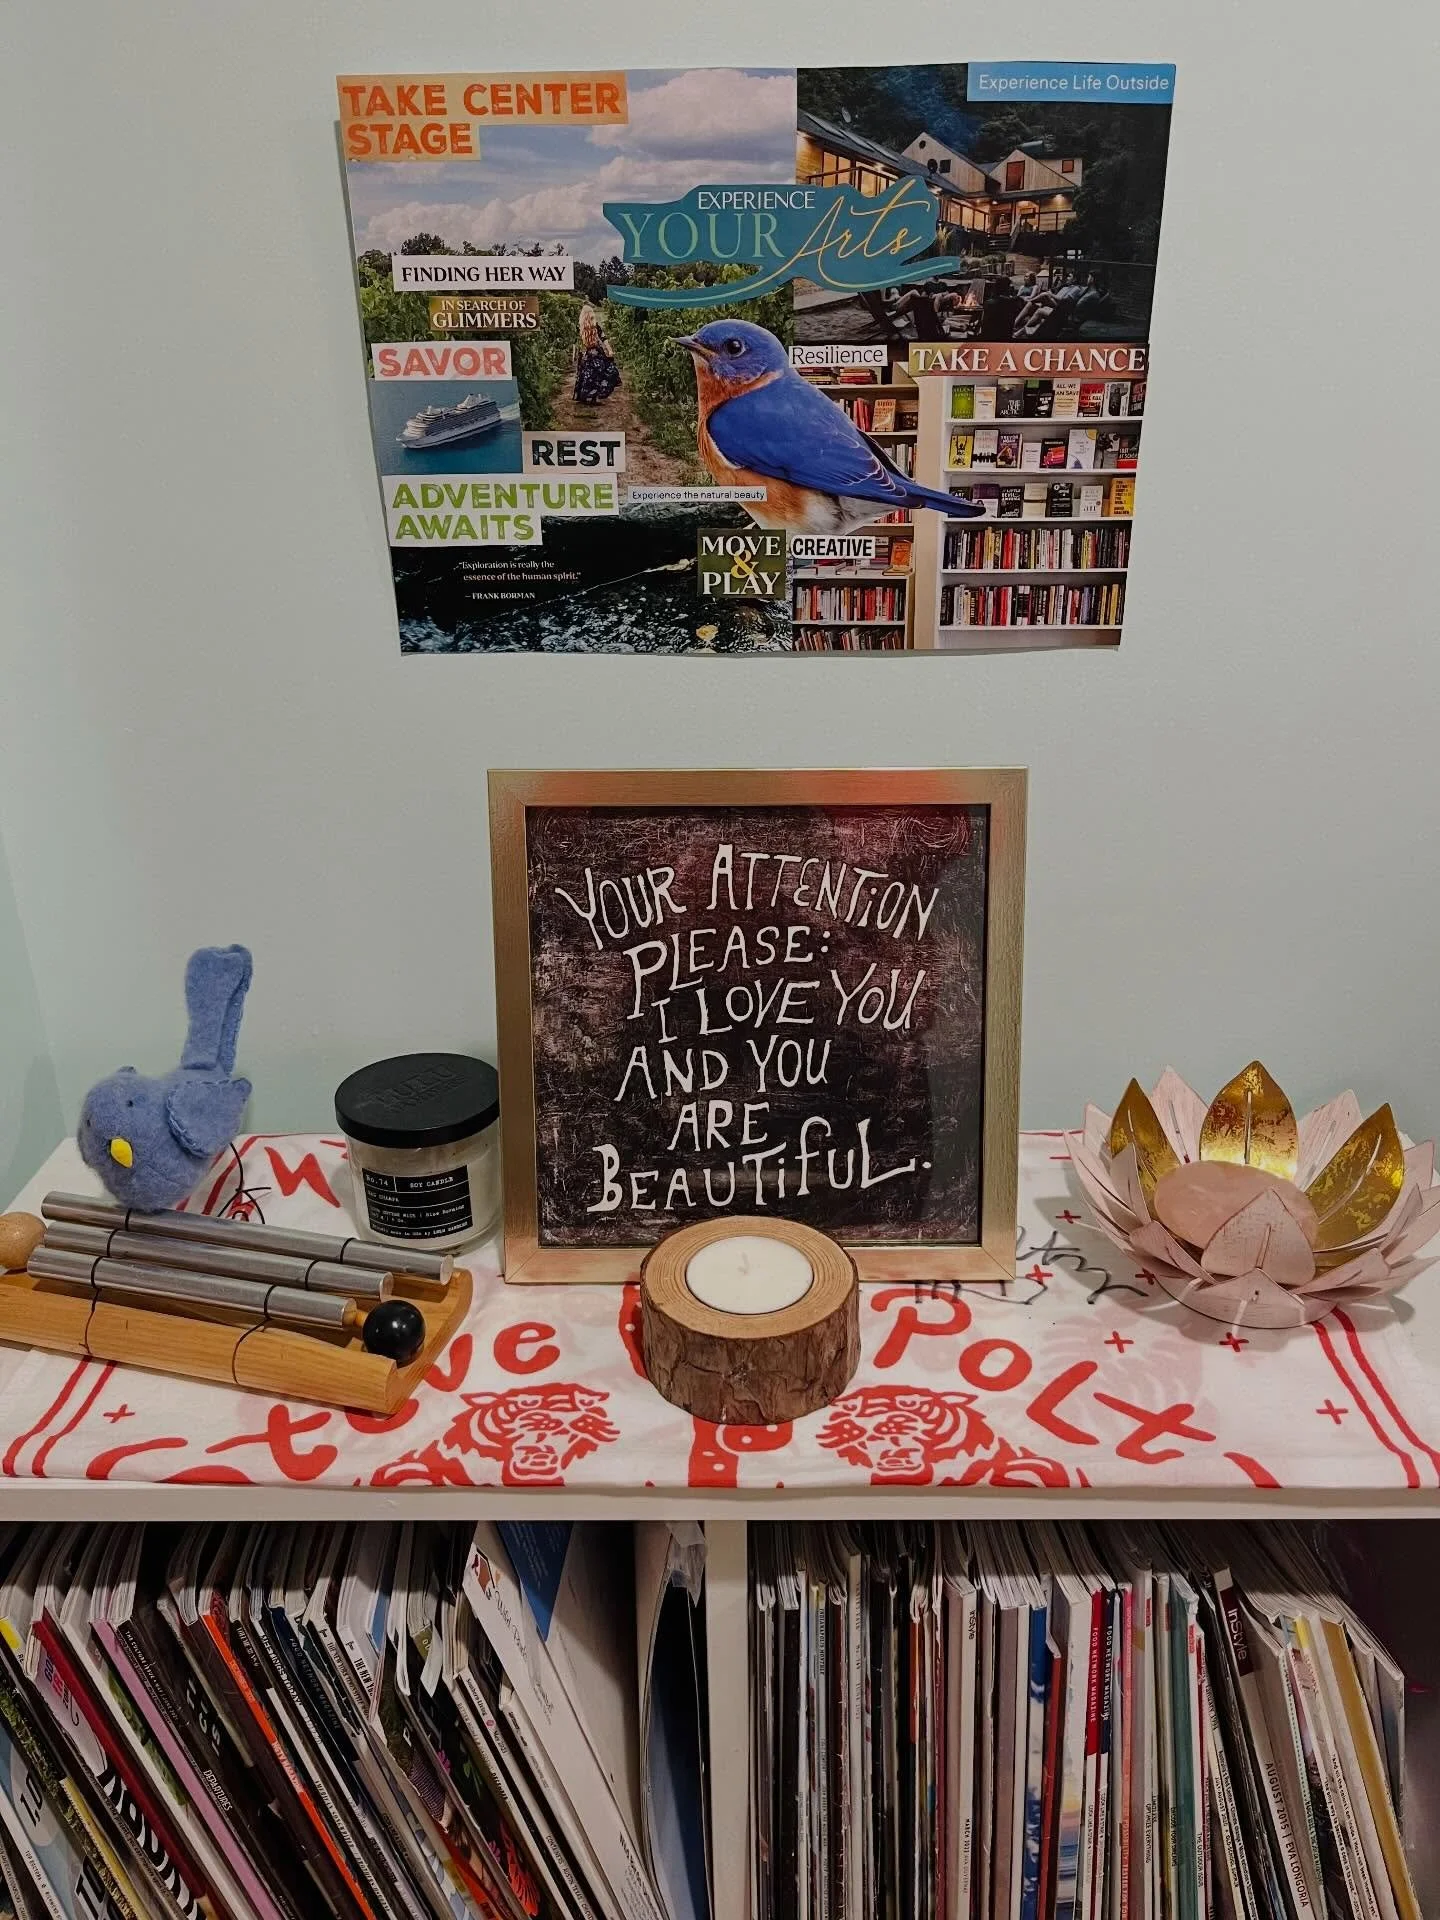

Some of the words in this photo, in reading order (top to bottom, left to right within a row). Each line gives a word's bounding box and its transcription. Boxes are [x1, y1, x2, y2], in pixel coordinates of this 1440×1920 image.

[979, 74, 1068, 91] Experience
[1073, 75, 1102, 90] Life
[1106, 75, 1169, 90] Outside
[342, 84, 448, 117] TAKE
[463, 82, 622, 116] CENTER
[349, 123, 473, 155] STAGE
[698, 191, 816, 210] EXPERIENCE
[619, 212, 786, 260] YOUR
[402, 267, 480, 283] FINDING
[485, 267, 524, 282] HER
[528, 266, 566, 282] WAY
[441, 301, 455, 312] IN
[457, 301, 507, 311] SEARCH
[509, 301, 526, 311] OF
[432, 312, 537, 329] GLIMMERS
[378, 347, 508, 377] SAVOR
[791, 346, 884, 364] Resilience
[912, 348, 989, 372] TAKE
[998, 349, 1019, 372] A
[1023, 348, 1146, 372] CHANCE
[531, 440, 621, 467] REST
[393, 483, 614, 509] ADVENTURE
[632, 491, 682, 500] Experience
[684, 491, 698, 499] the
[700, 490, 732, 499] natural
[734, 490, 765, 500] beauty
[396, 514, 535, 540] AWAITS
[701, 536, 781, 556] MOVE
[792, 538, 873, 557] CREATIVE
[496, 572, 506, 580] of
[508, 572, 520, 580] the
[522, 572, 552, 580] human
[510, 561, 516, 569] is
[518, 560, 540, 570] really
[542, 560, 555, 568] the
[730, 549, 760, 579] &
[702, 571, 781, 596] PLAY
[555, 867, 687, 950] YOUR
[623, 926, 831, 1020] PLEASE:
[650, 998, 677, 1044] I
[695, 977, 820, 1036] LOVE
[831, 963, 926, 1031] YOU
[614, 1046, 729, 1102] AND
[746, 1035, 832, 1093] YOU
[668, 1100, 771, 1152] ARE
[426, 1176, 454, 1187] CANDLE
[1227, 1608, 1248, 1661] InStyle
[353, 1657, 365, 1670] THE
[359, 1668, 372, 1684] NEW
[465, 1678, 481, 1701] Southern
[476, 1699, 488, 1716] Living
[203, 1769, 233, 1812] DEPARTURES
[1225, 1786, 1234, 1803] Center
[1263, 1761, 1285, 1805] AUGUST
[1229, 1807, 1238, 1825] Climate
[1275, 1807, 1289, 1830] 2015
[1325, 1791, 1333, 1803] only
[1333, 1824, 1343, 1846] become
[1231, 1825, 1242, 1842] change
[1283, 1841, 1297, 1860] EVA
[1288, 1860, 1311, 1907] LONGORIA
[1359, 1867, 1368, 1879] been
[1362, 1880, 1374, 1904] invented
